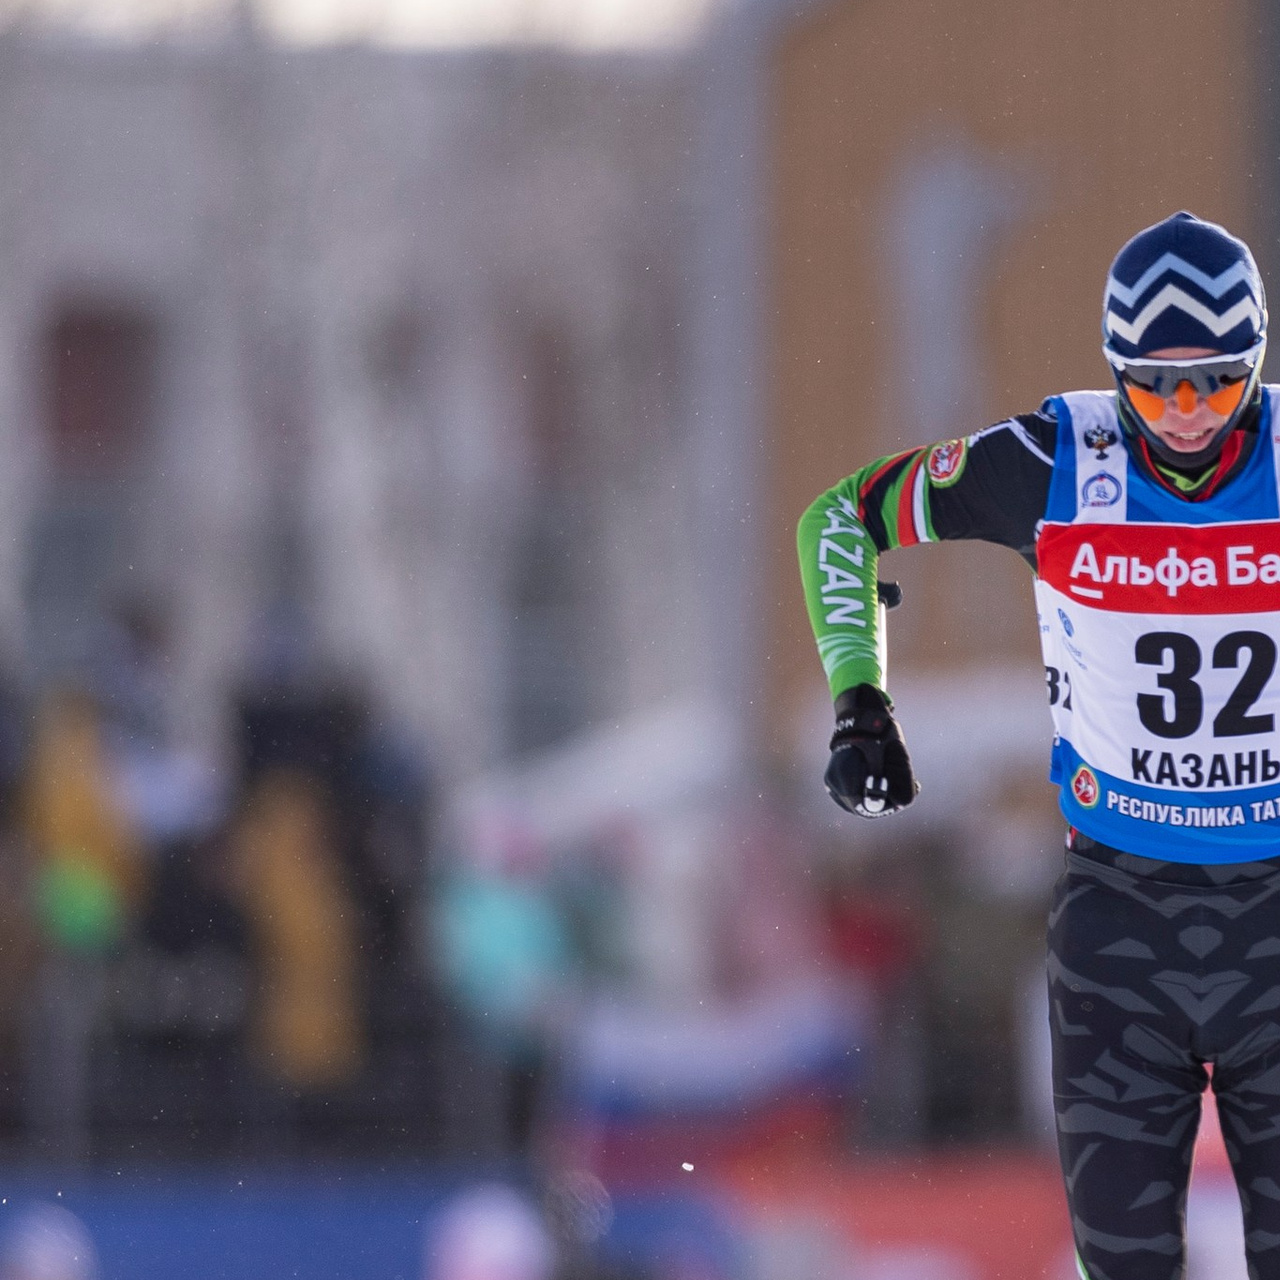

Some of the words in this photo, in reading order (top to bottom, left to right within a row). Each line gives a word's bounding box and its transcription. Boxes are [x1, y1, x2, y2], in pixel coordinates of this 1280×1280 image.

[1069, 542, 1218, 599] Альфа
[1133, 630, 1278, 739] 32
[1106, 790, 1246, 828] РЕСПУБЛИКА
